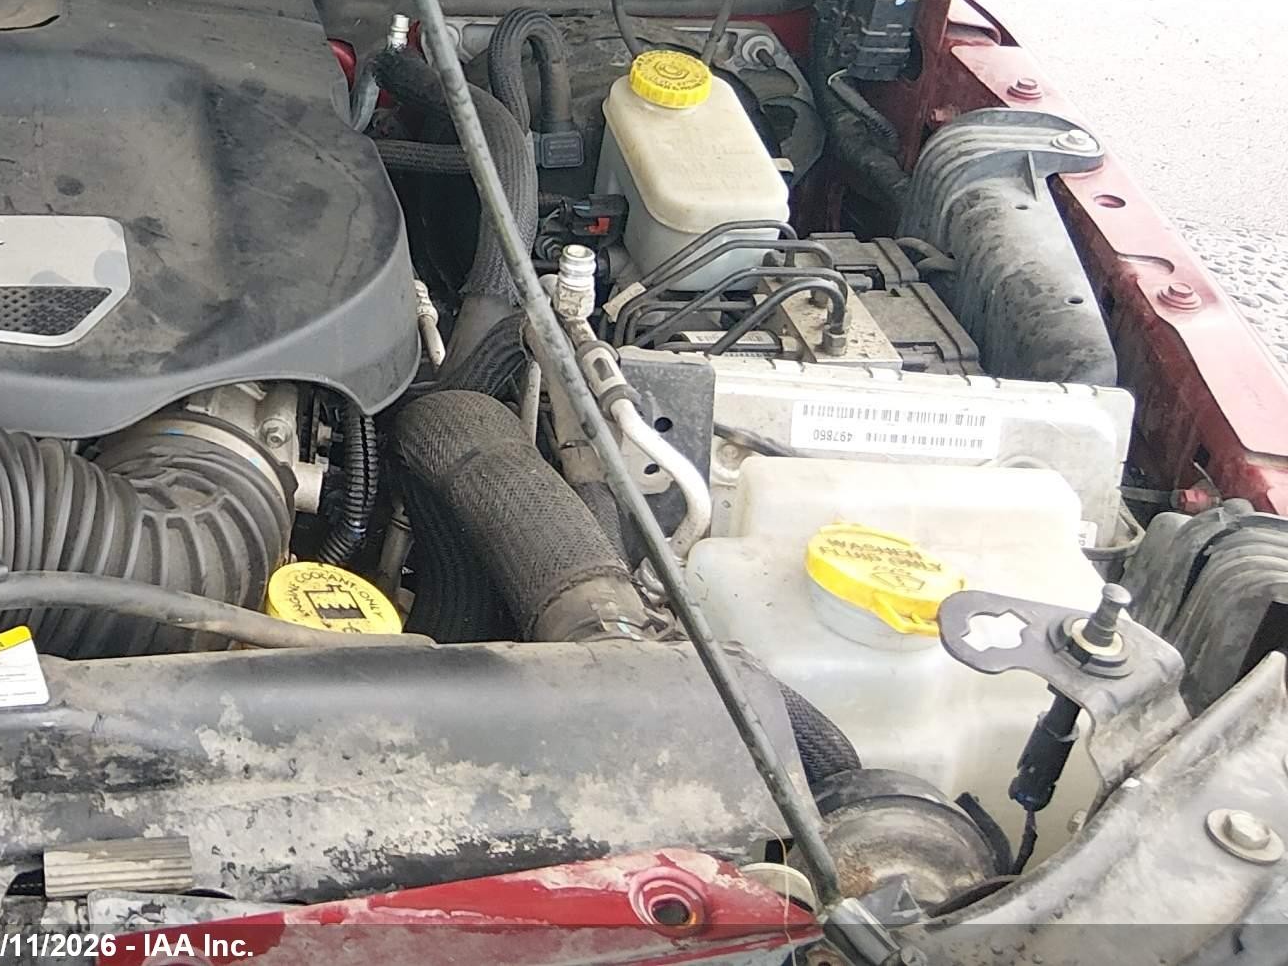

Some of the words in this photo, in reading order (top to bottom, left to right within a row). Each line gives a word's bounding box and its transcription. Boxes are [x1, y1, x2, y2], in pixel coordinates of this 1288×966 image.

[819, 545, 883, 563] FLUID
[887, 556, 943, 573] ONLY
[295, 570, 356, 590] COOLANT
[359, 590, 385, 621] ONLY
